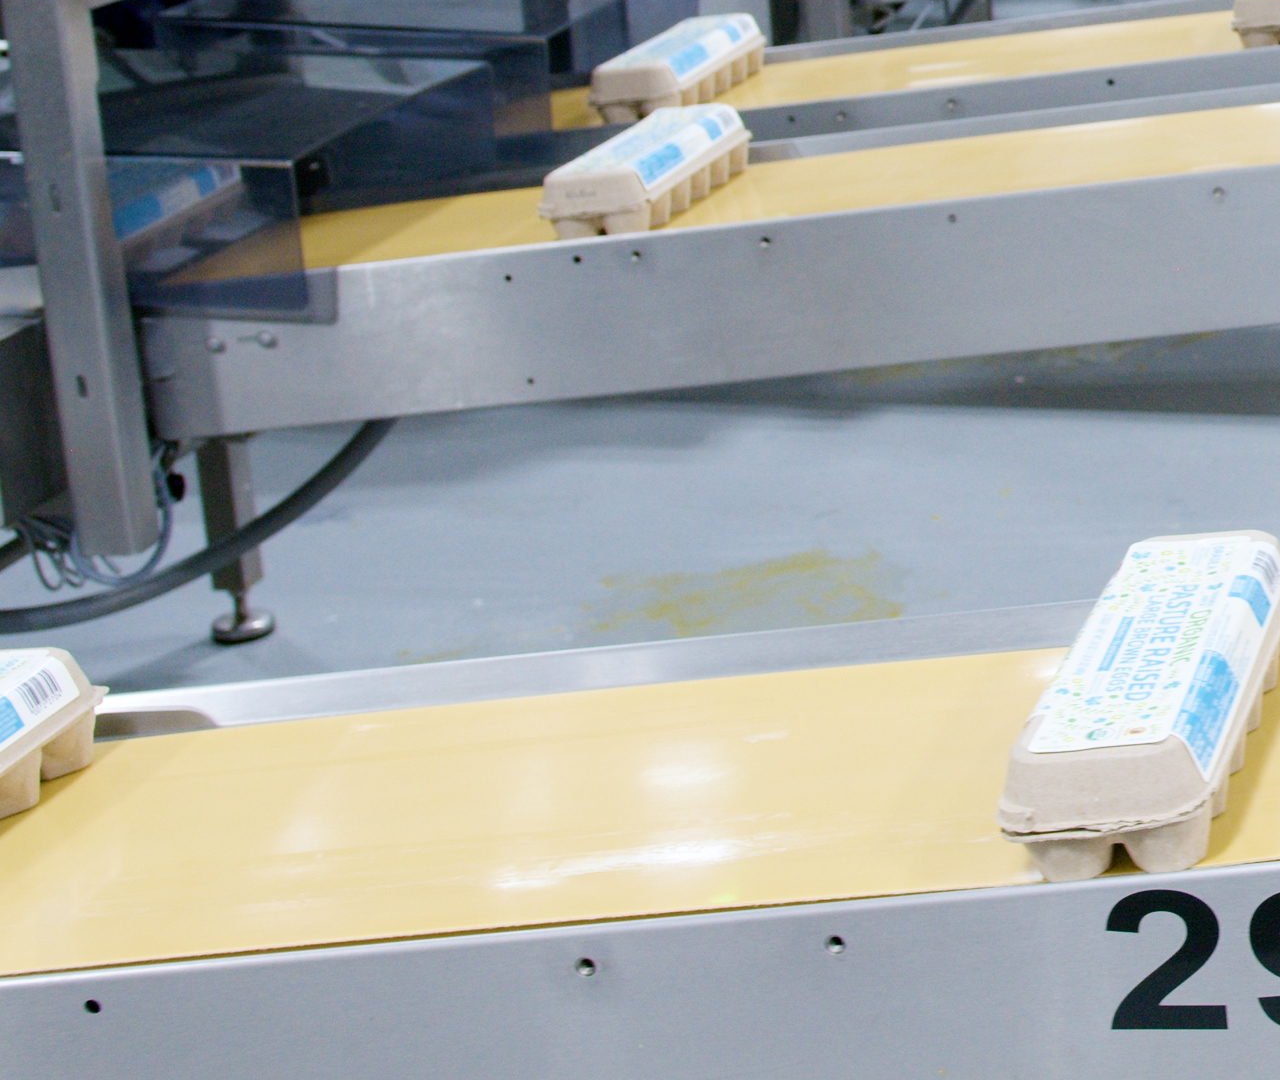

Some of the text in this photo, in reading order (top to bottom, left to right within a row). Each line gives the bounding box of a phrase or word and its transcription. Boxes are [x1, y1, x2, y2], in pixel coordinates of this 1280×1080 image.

[1137, 594, 1166, 625] LARGE
[1118, 627, 1152, 664] BROWN
[1124, 584, 1200, 702] PASTURE RAISED
[1169, 609, 1212, 667] ORGANIC
[1105, 667, 1133, 692] EGGS
